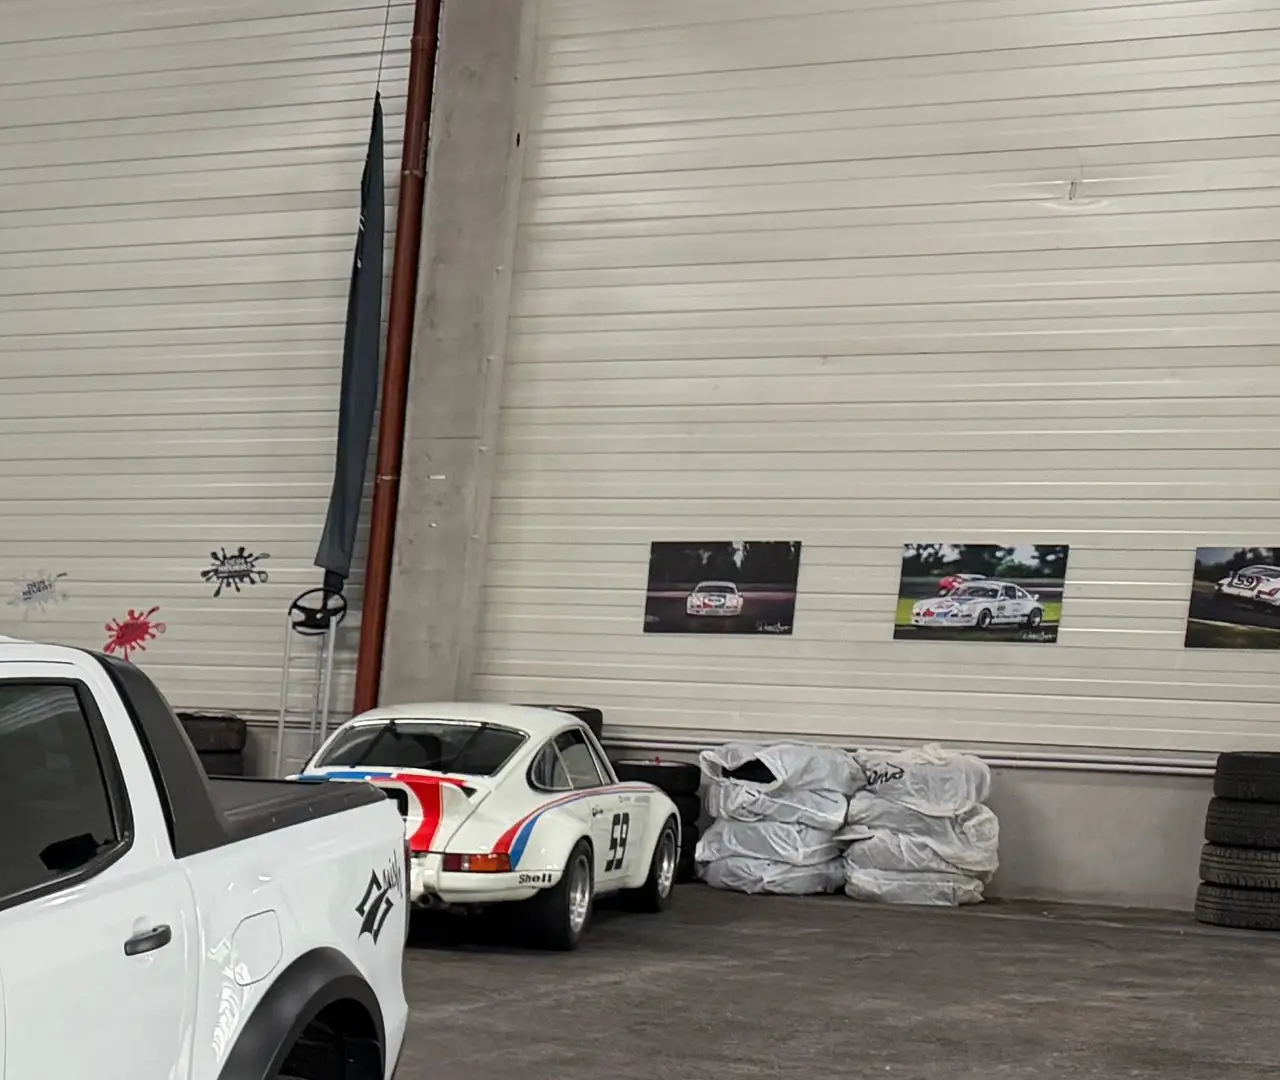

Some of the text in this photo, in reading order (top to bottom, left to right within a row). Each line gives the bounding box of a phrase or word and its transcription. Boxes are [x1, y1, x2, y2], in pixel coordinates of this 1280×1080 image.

[1235, 575, 1254, 587] 59
[604, 812, 629, 872] 59
[518, 873, 552, 885] Shell
